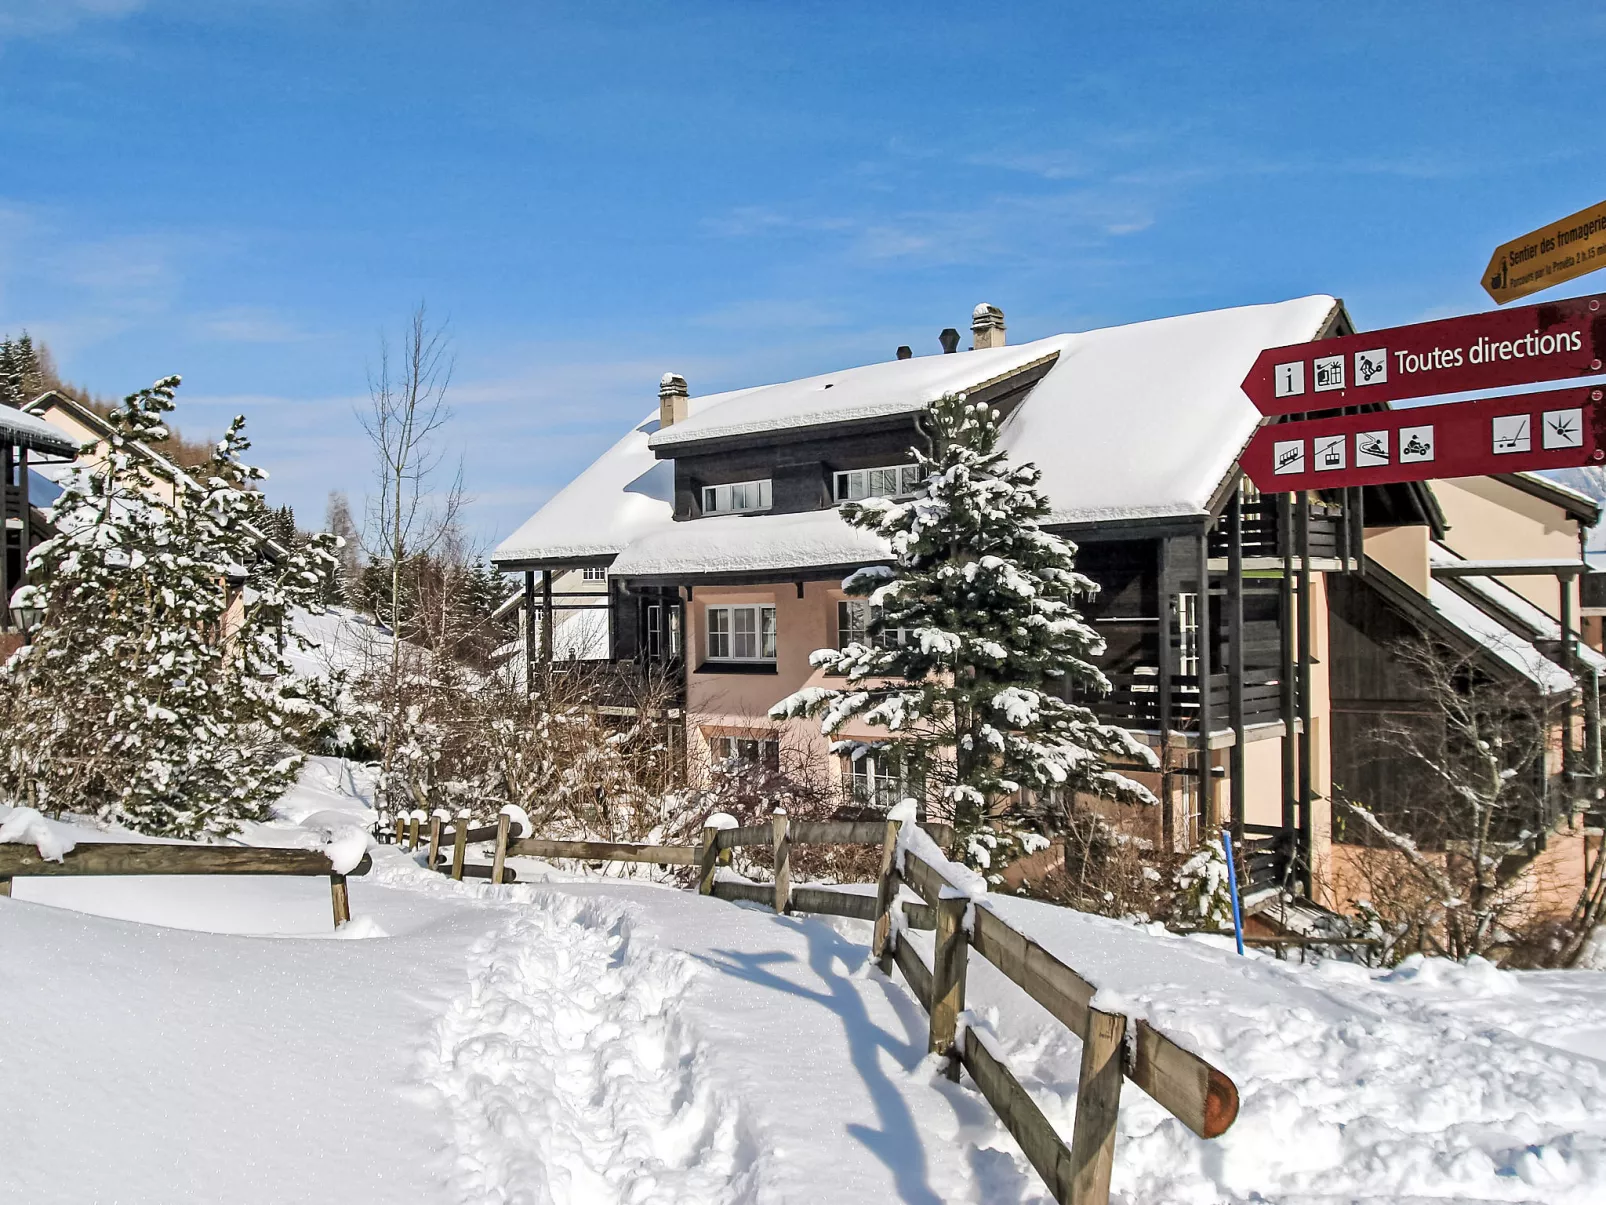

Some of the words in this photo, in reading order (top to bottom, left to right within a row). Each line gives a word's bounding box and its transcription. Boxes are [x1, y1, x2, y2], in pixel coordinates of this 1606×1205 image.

[1509, 244, 1538, 267] Sentier
[1541, 237, 1555, 254] des
[1557, 215, 1606, 247] fromagerie
[1394, 347, 1462, 374] Toutes
[1469, 330, 1581, 363] directions
